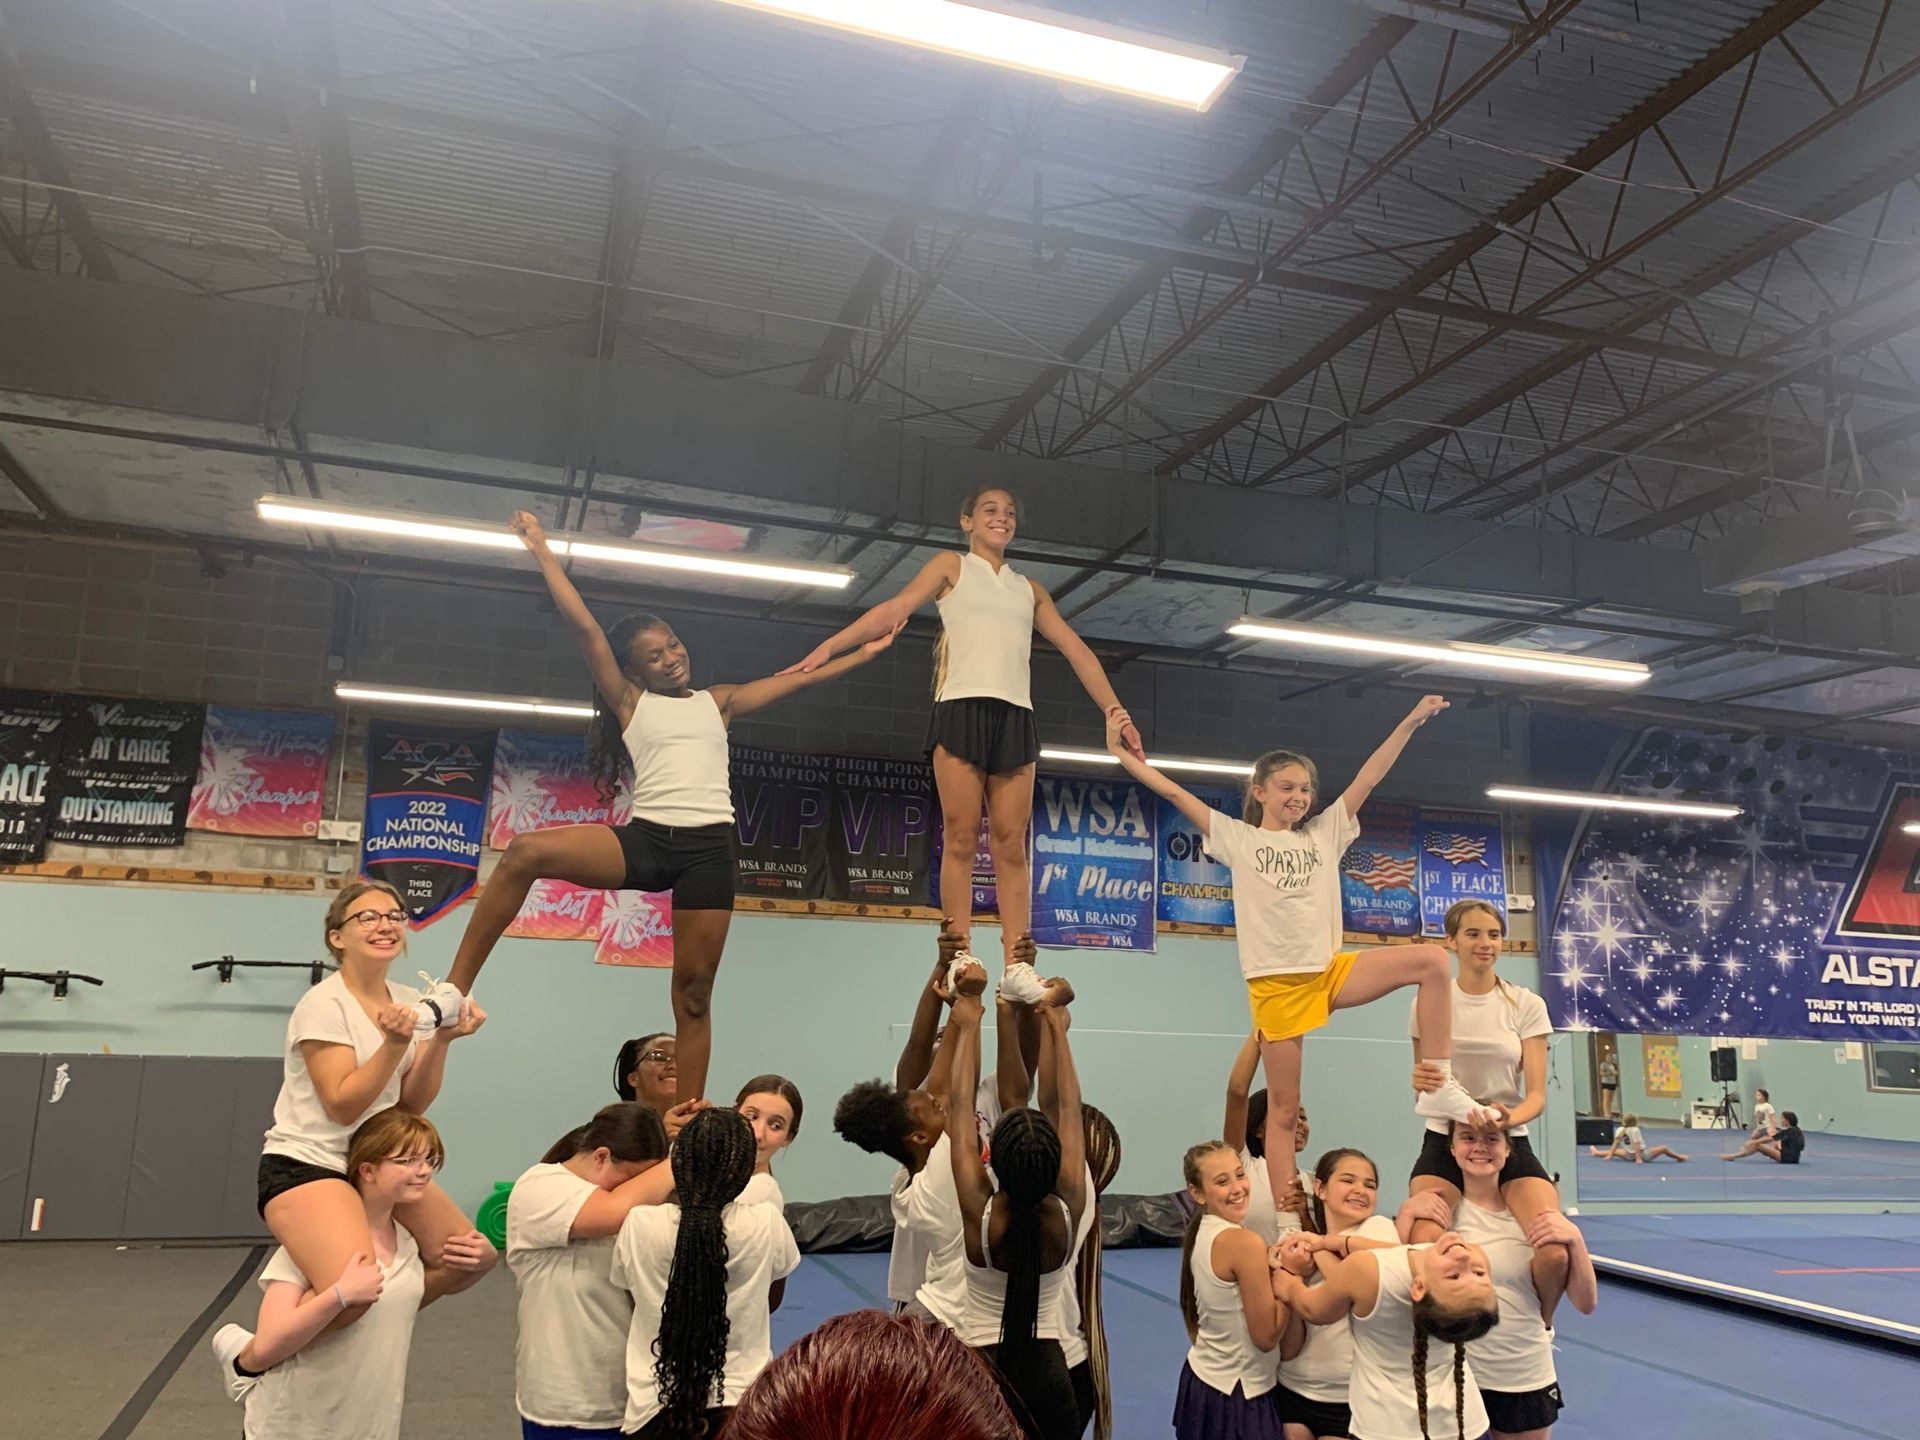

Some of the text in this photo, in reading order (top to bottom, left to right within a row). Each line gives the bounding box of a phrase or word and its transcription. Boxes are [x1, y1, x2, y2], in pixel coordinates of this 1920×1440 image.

[90, 736, 172, 764] AT LARGE
[381, 738, 482, 767] ACA
[730, 747, 833, 768] HIGH POINT
[730, 763, 830, 784] CHAMPION
[836, 757, 933, 777] HIGH POINT
[836, 772, 932, 792] CHAMPION
[216, 773, 320, 816] Champion
[61, 796, 175, 825] OUTSTANDING
[408, 800, 446, 816] 2022
[515, 794, 609, 834] Champion
[734, 780, 830, 850] VIP
[1038, 779, 1149, 839] WSA
[385, 817, 466, 837] NATIONAL
[839, 789, 930, 857] VIP
[366, 832, 480, 857] CHAMPIONSHIP
[738, 859, 808, 874] WSA BRANDS
[847, 867, 914, 880] WSA BRANDS
[408, 879, 433, 889] THIRD
[786, 879, 802, 889] WSA
[893, 885, 910, 895] WSA
[1077, 864, 1152, 901] Place
[1451, 871, 1503, 895] PLACE
[407, 888, 433, 898] PLACE
[1350, 896, 1412, 910] WSA BRANDS
[1055, 908, 1137, 927] WSA BRANDS
[1393, 916, 1408, 926] WSA
[1112, 936, 1132, 947] WSA
[1805, 998, 1845, 1011] TRUST
[1846, 1000, 1858, 1011] IN
[1860, 1001, 1884, 1012] THE
[1884, 1002, 1915, 1014] LORD
[1809, 1012, 1821, 1023] IN
[1822, 1012, 1846, 1024] ALL
[1848, 1013, 1881, 1025] YOUR
[1882, 1015, 1915, 1027] WAYS
